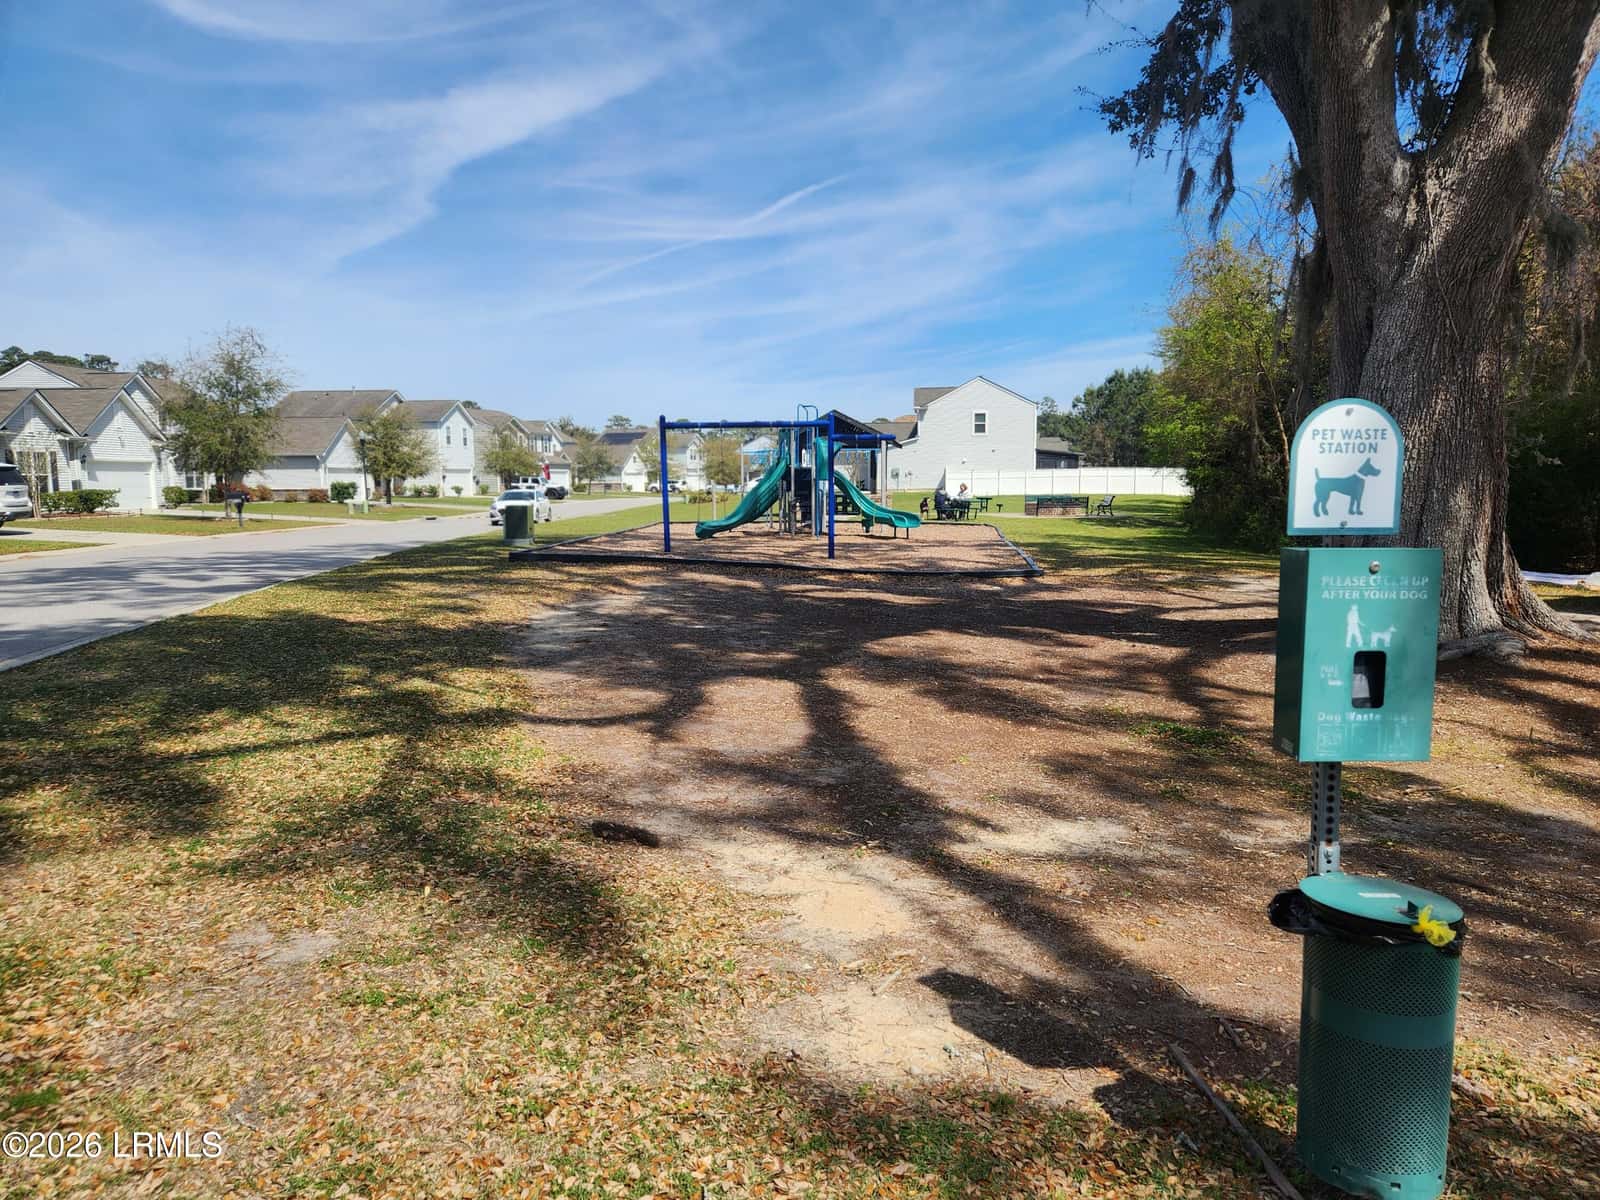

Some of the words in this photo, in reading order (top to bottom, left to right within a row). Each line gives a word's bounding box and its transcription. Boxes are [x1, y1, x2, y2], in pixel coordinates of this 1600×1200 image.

[1312, 428, 1337, 441] PET
[1340, 428, 1389, 441] WASTE
[1319, 441, 1378, 454] STATION
[1321, 575, 1366, 587] PLEASE
[1411, 575, 1430, 587] UP
[1321, 590, 1360, 600] AFTER
[1363, 590, 1397, 600] YOUR
[1399, 590, 1428, 600] DOG
[1318, 711, 1341, 722] Dog
[1345, 711, 1382, 721] Waste
